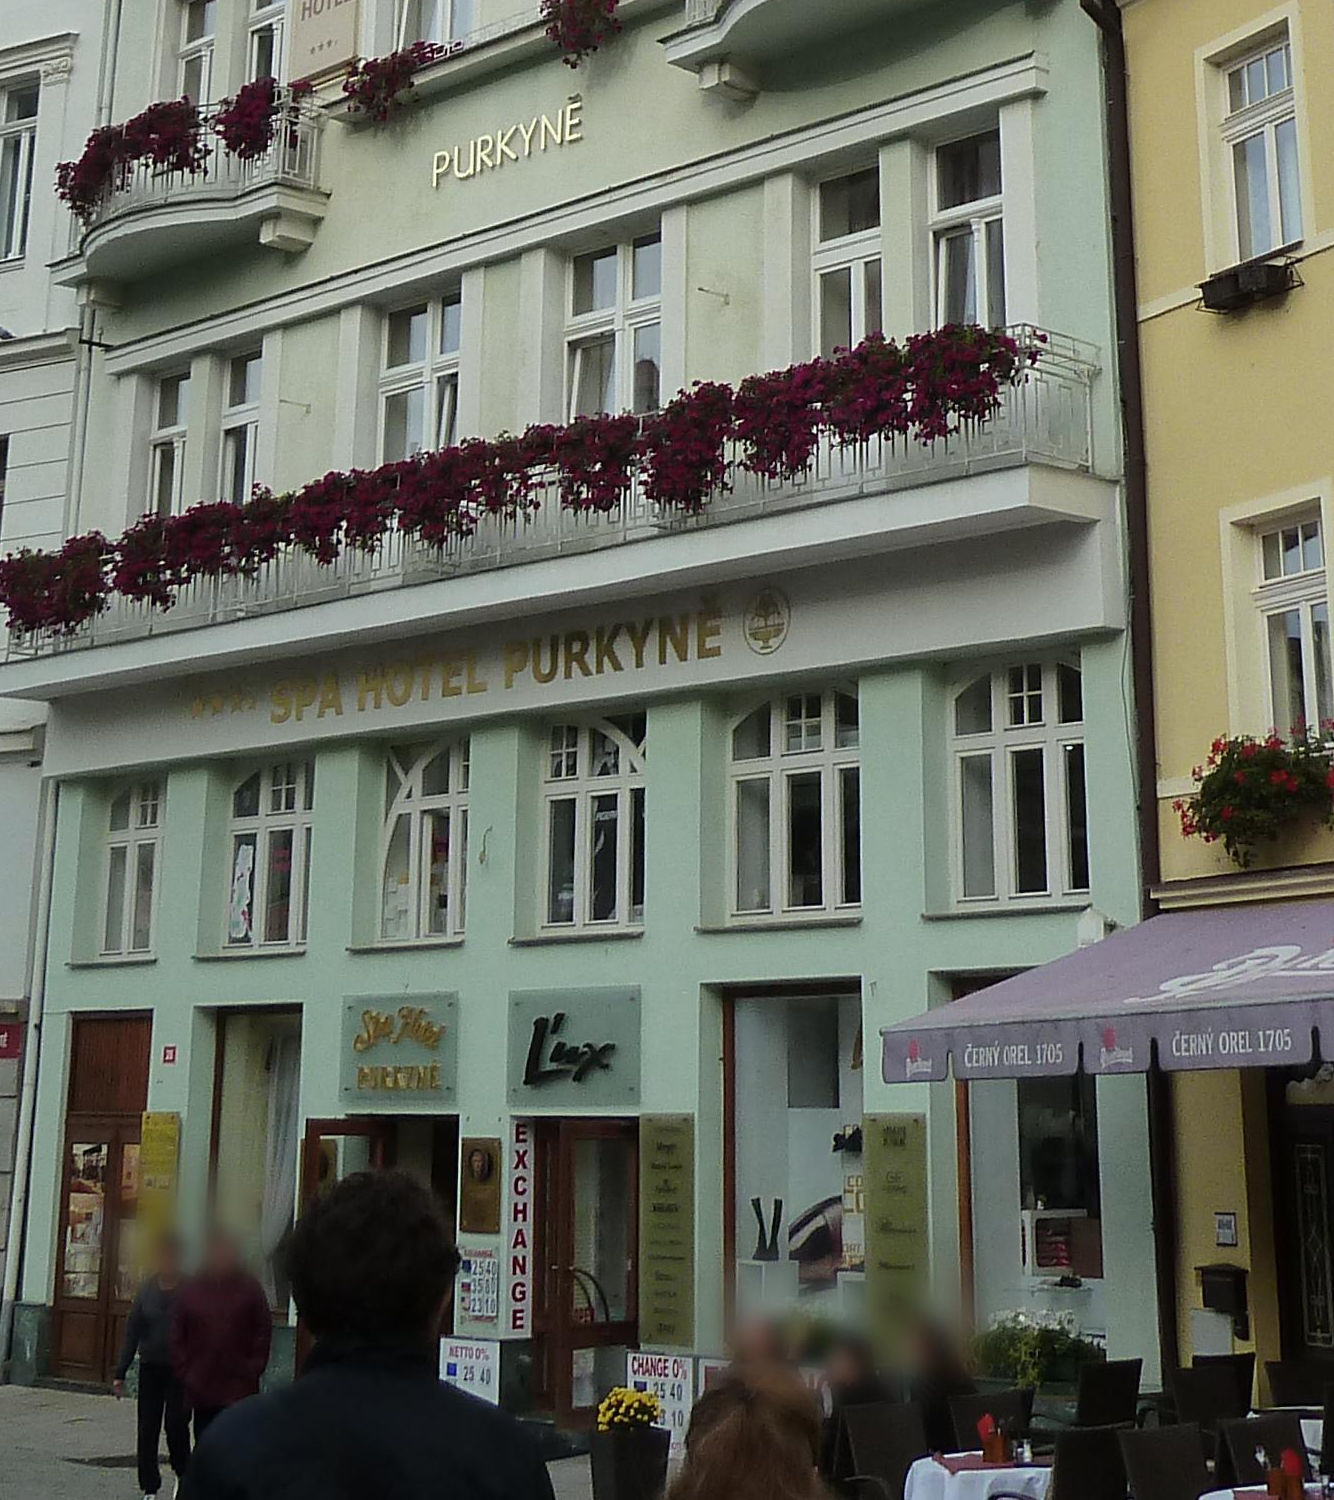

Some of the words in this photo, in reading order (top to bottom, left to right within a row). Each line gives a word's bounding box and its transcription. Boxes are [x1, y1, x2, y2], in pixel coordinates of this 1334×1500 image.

[431, 93, 584, 189] PURKYNĚ
[270, 670, 344, 724] SPA
[356, 651, 487, 712] HOTEL
[504, 596, 722, 690] PURKYNĚ
[964, 1041, 1000, 1067] ČERNÝ
[1003, 1045, 1032, 1065] OREL
[1035, 1044, 1063, 1064] 1705
[1171, 1027, 1215, 1056] ČERNÝ
[1218, 1031, 1253, 1055] OREL
[1258, 1028, 1292, 1052] 1705
[511, 1123, 528, 1331] EXCHANGE
[631, 1355, 669, 1378] CHANGE
[672, 1356, 688, 1380] 0%
[669, 1384, 683, 1401] 40
[671, 1410, 684, 1428] 10
